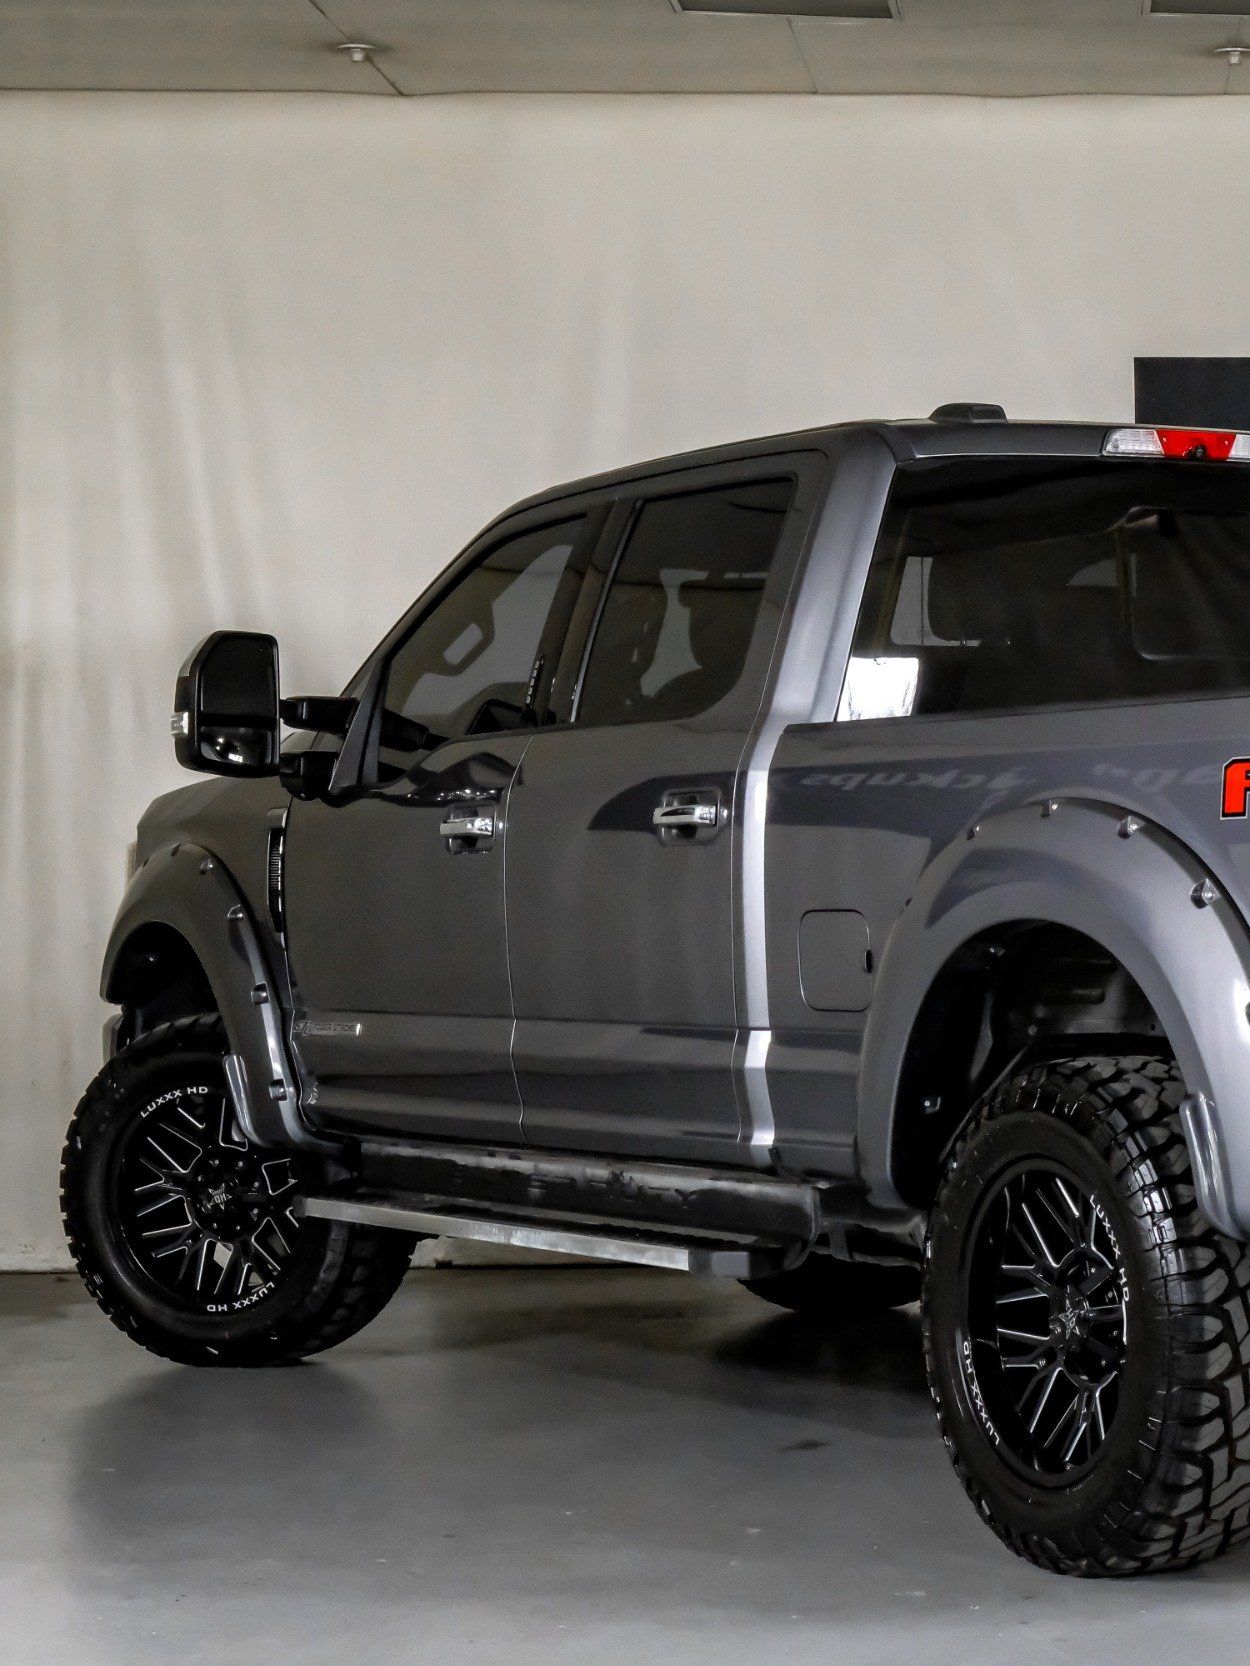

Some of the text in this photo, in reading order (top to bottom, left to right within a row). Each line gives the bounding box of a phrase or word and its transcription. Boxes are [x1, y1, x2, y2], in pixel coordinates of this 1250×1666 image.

[140, 1086, 209, 1118] LUXXX HD
[1089, 1194, 1129, 1302] LUXXX HD
[206, 1281, 275, 1312] LUXXX HD
[963, 1341, 1000, 1446] LUXXX HD
